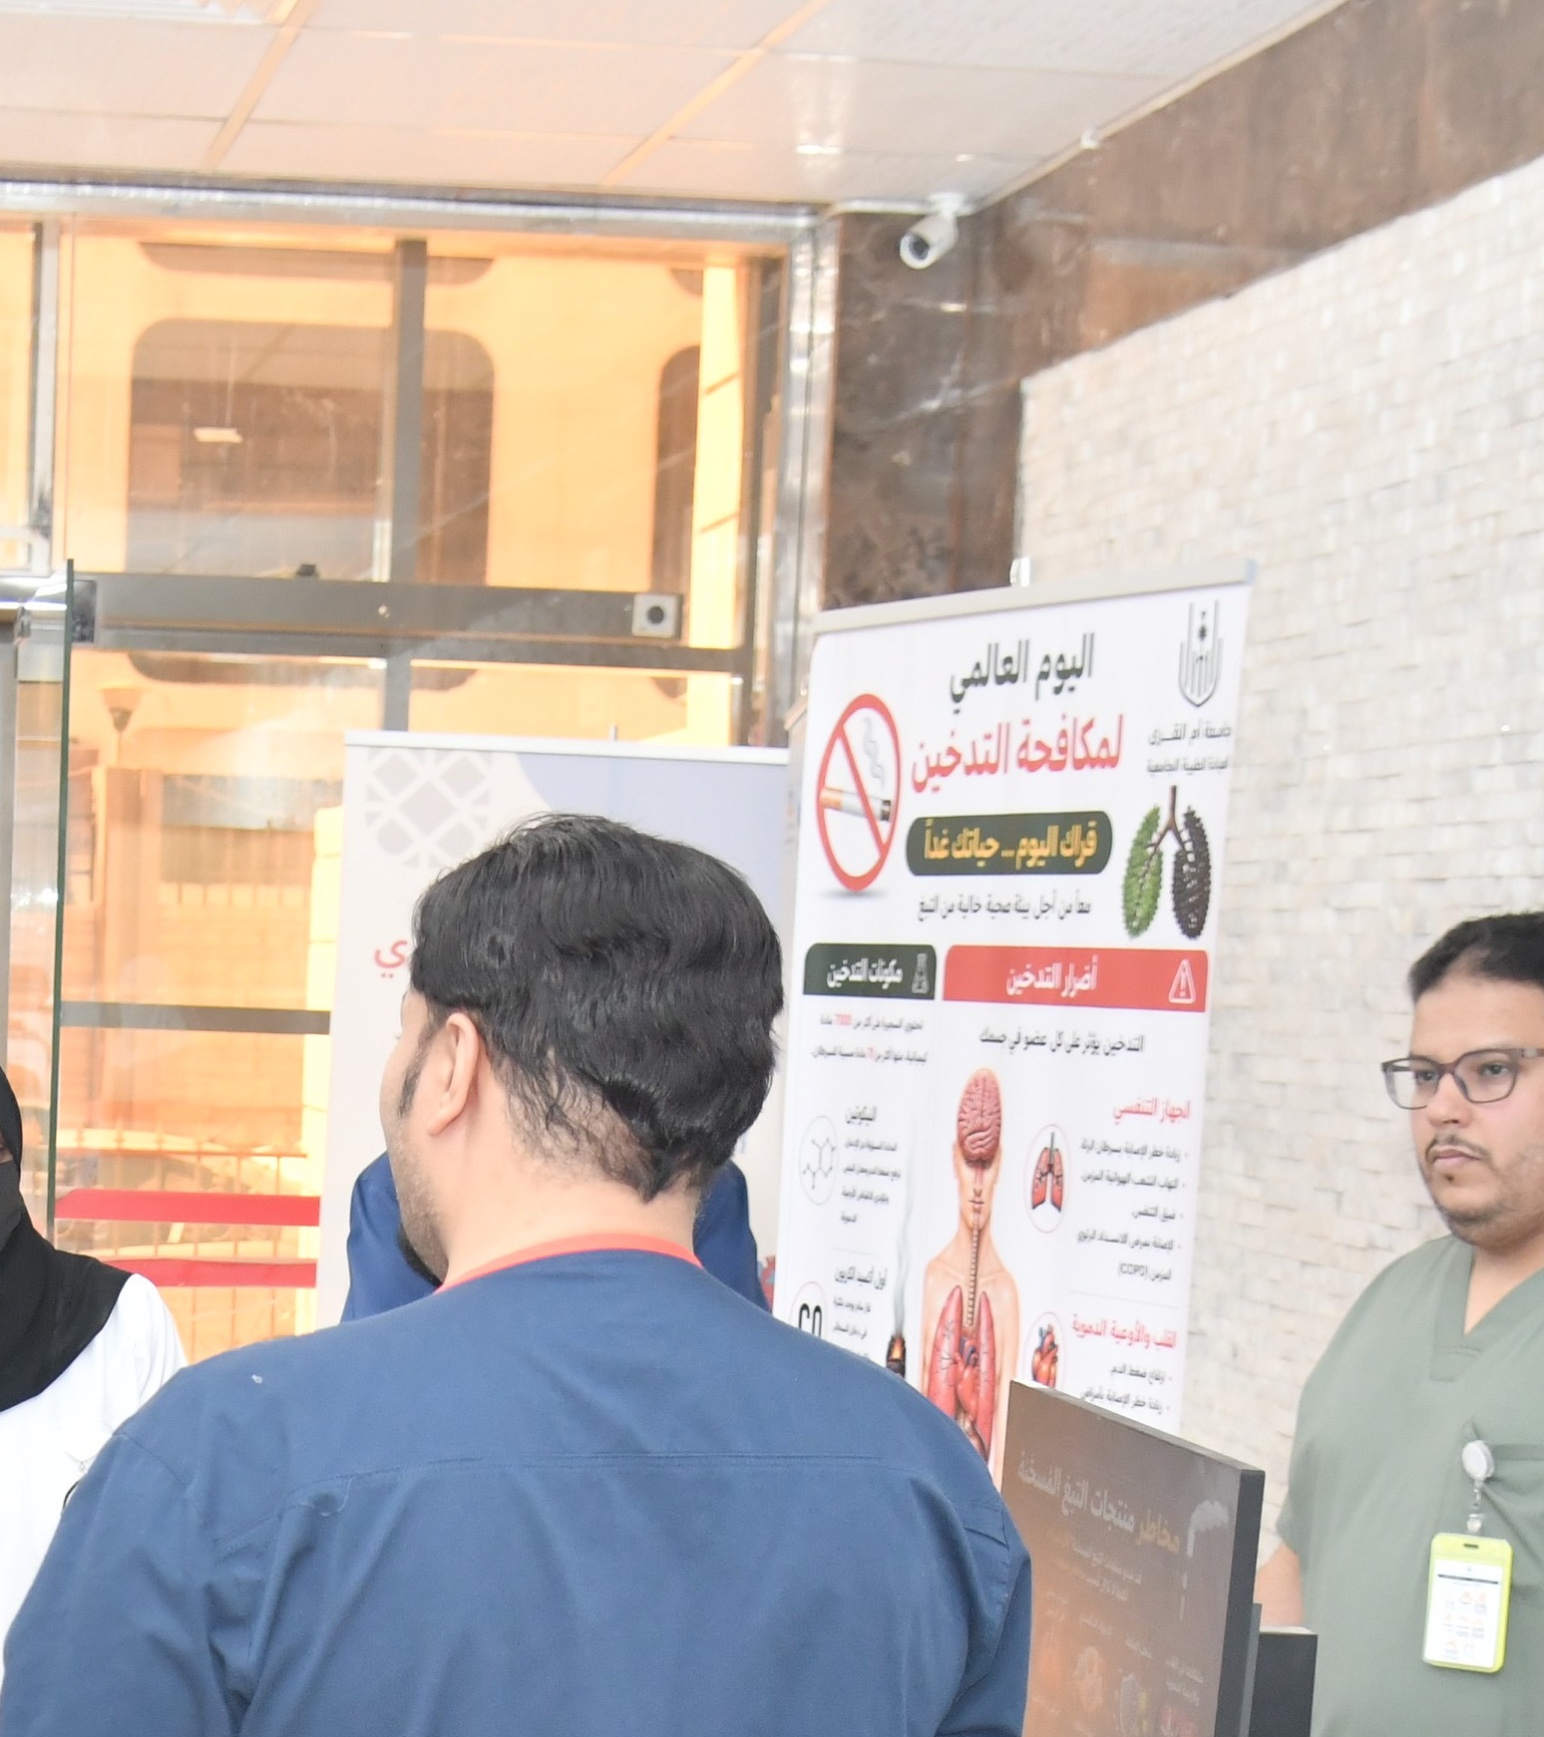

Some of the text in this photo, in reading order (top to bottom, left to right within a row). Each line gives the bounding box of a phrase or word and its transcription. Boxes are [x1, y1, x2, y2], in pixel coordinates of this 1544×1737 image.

[950, 632, 1095, 714] اليوم العالمي
[913, 711, 1123, 793] لمكافحة التدخين
[1015, 825, 1059, 870] اليوم
[826, 957, 869, 989] التدخين
[1006, 961, 1061, 996] التدخين
[1102, 1033, 1145, 1056] التدخين
